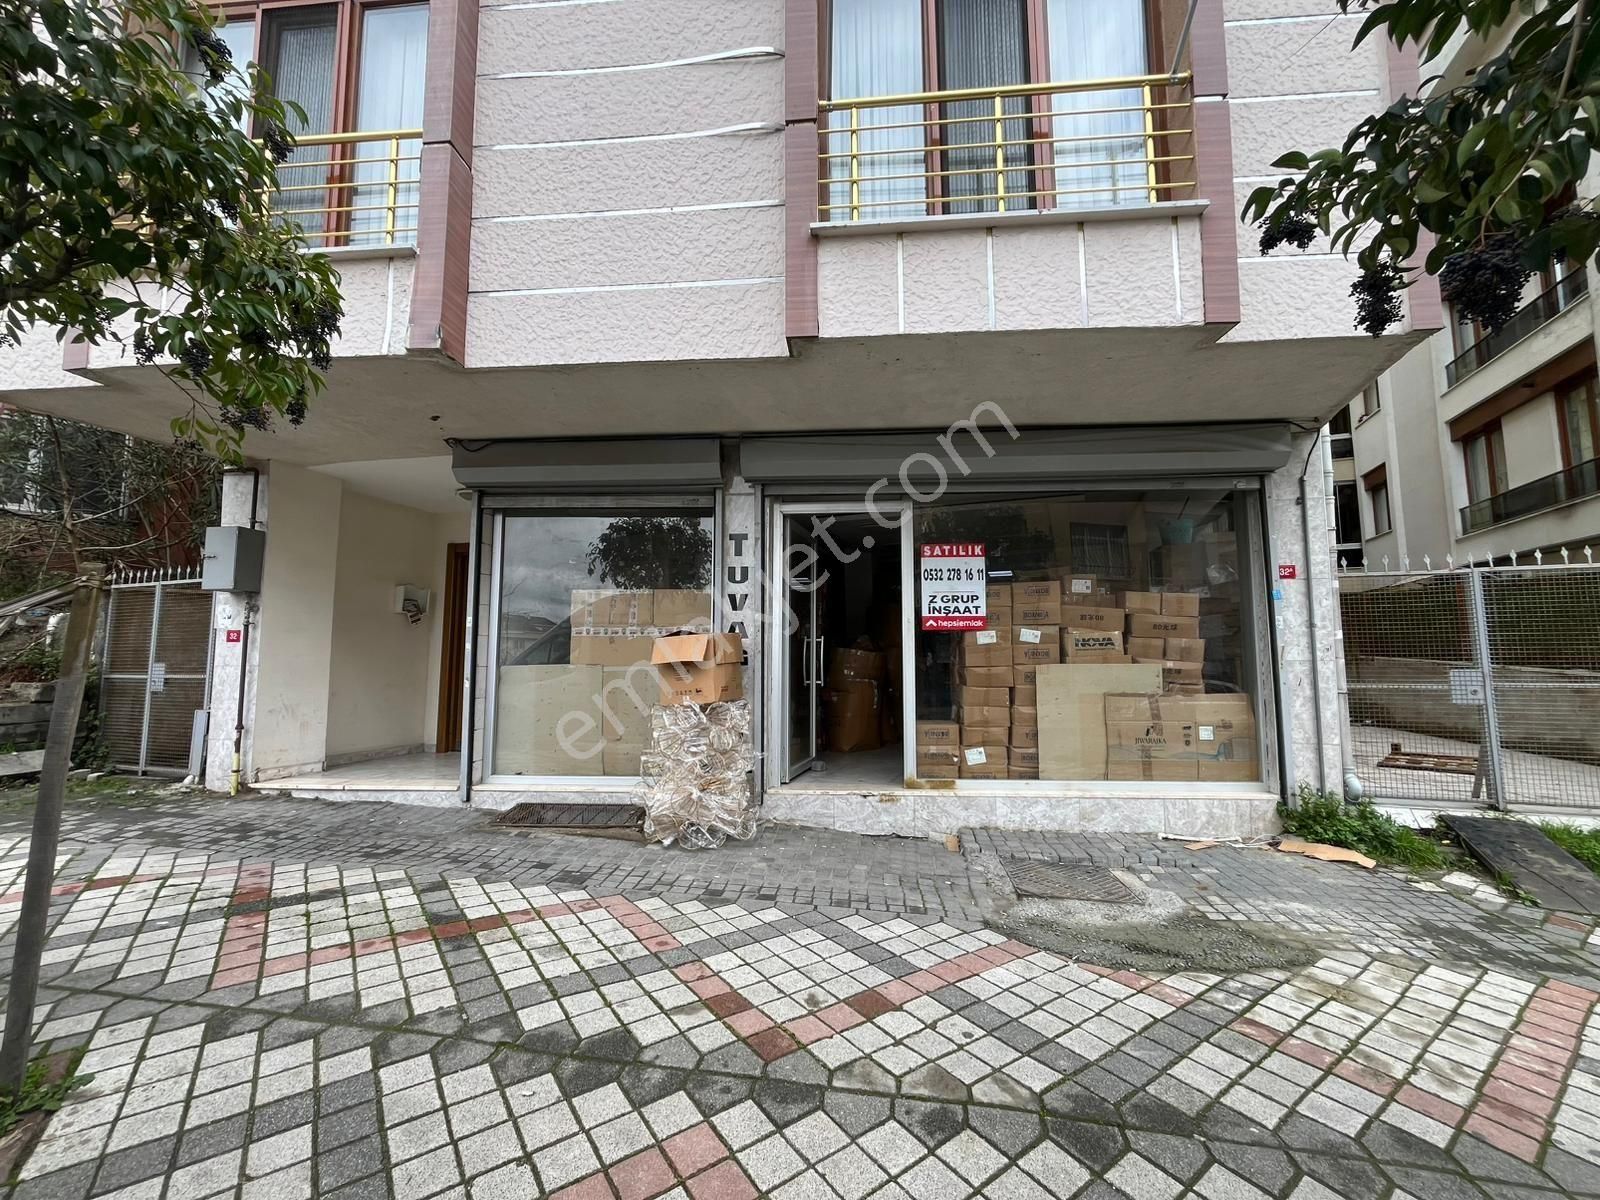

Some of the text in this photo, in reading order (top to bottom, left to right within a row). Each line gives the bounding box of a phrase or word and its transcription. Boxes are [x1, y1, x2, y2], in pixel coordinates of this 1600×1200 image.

[924, 545, 982, 556] SATILIK
[923, 568, 984, 581] 0532 278 16 11
[928, 594, 980, 604] Z GRUP
[928, 603, 981, 616] İNŞAAT
[938, 619, 984, 628] hepsiemlak
